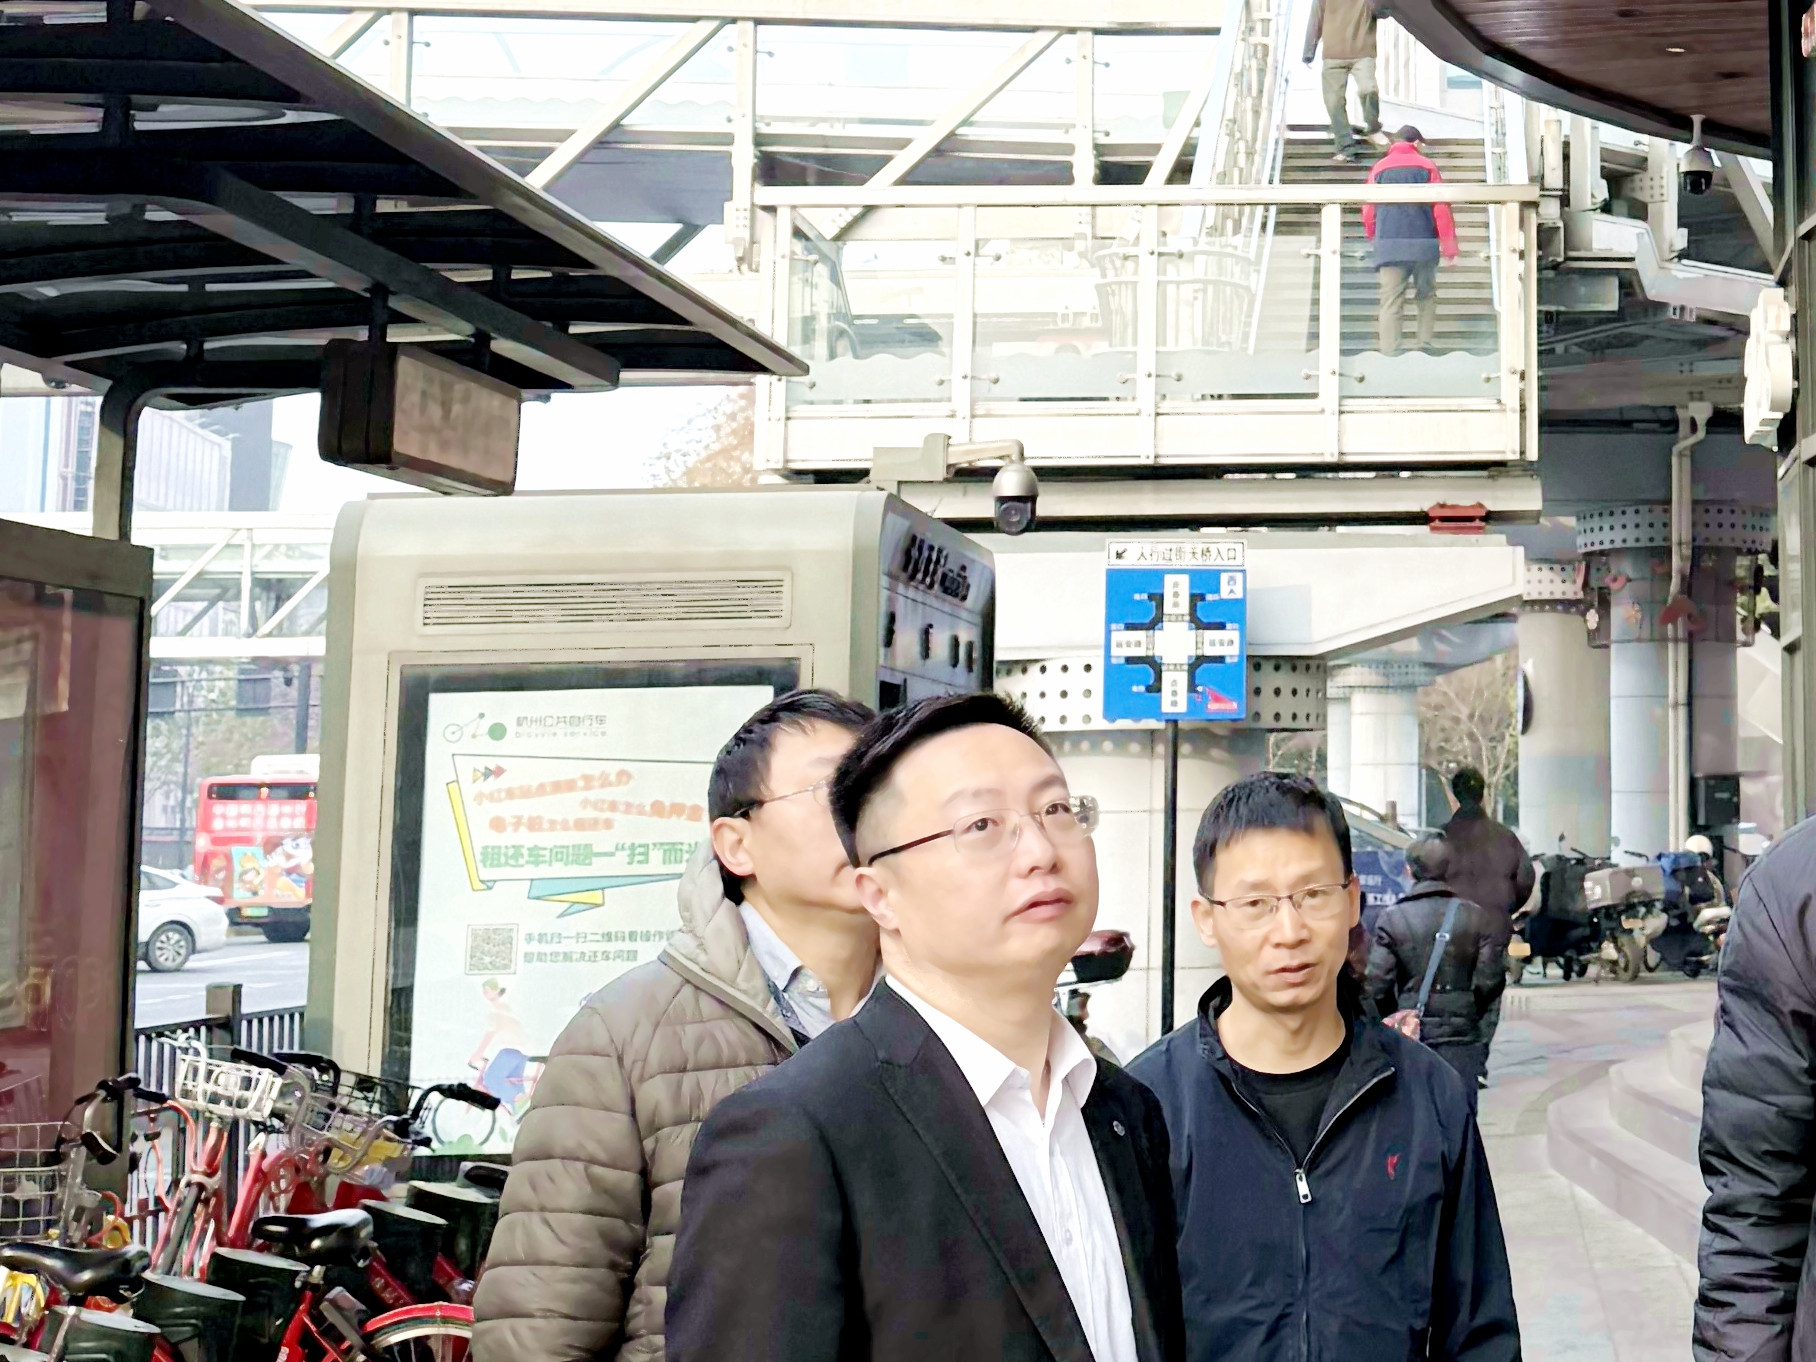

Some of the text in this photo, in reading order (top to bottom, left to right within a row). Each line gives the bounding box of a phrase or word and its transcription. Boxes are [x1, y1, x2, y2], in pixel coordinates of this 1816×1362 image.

[1137, 546, 1236, 562] 人行过街天桥入口
